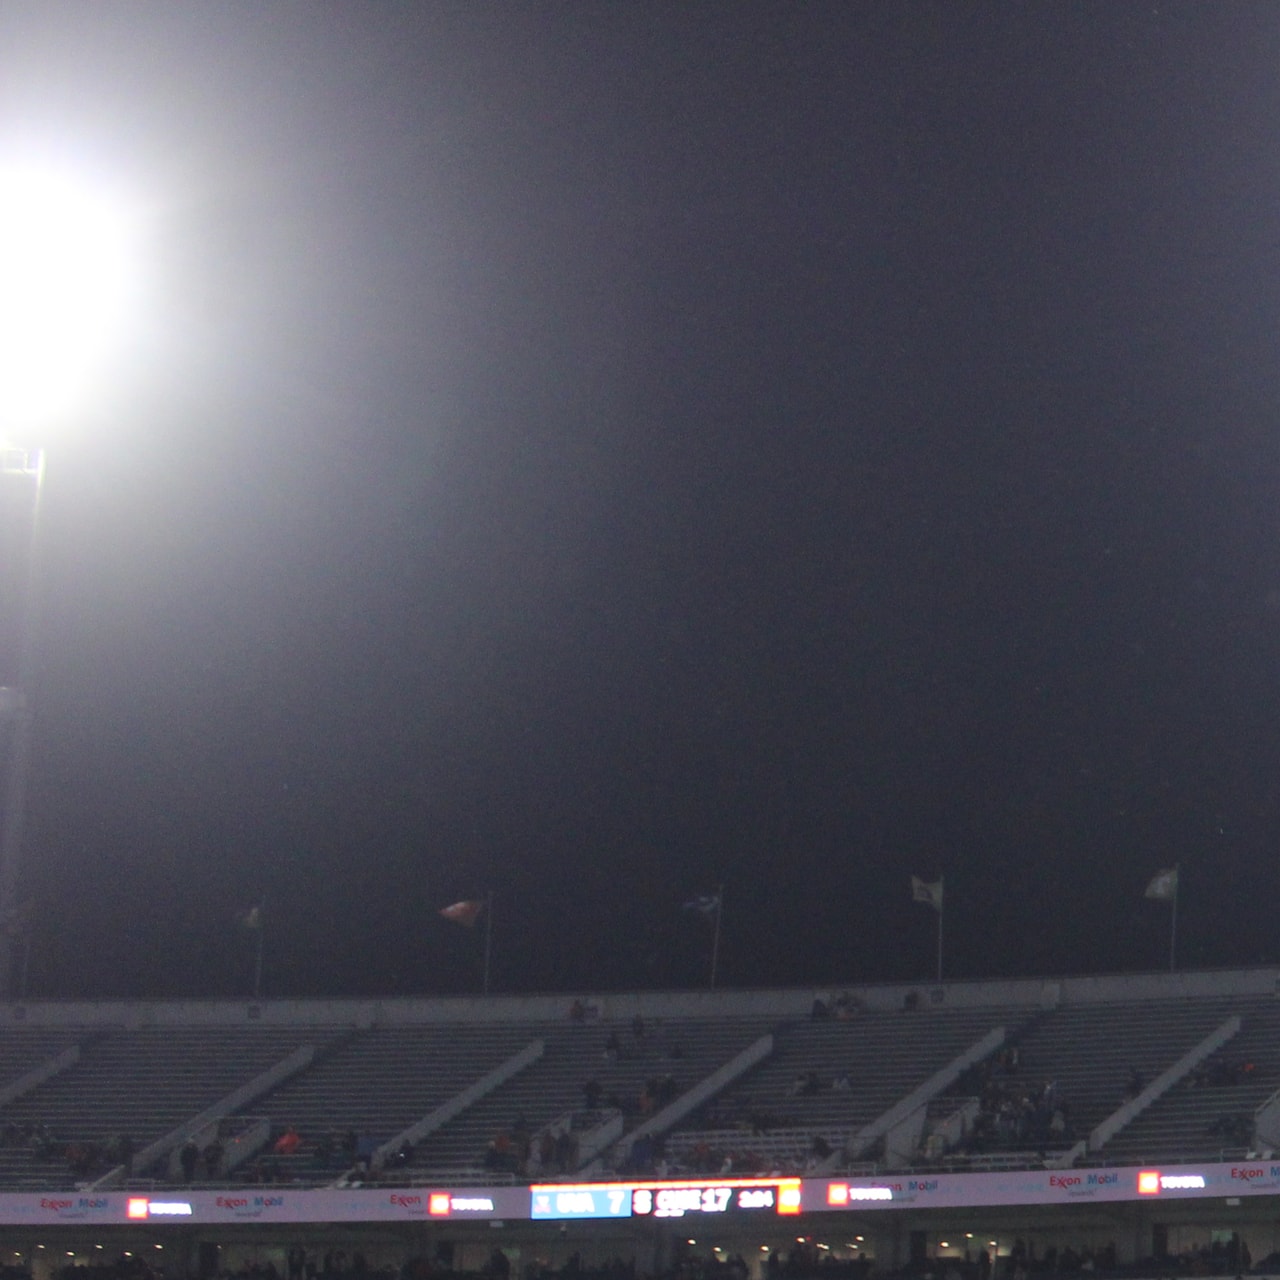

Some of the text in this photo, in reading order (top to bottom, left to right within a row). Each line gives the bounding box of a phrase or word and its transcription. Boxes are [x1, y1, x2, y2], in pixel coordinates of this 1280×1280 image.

[1231, 1168, 1263, 1181] Exxon
[1049, 1173, 1118, 1189] Exxon Mobil
[1160, 1176, 1205, 1188] TOYOTA
[849, 1188, 892, 1200] TOYOTA
